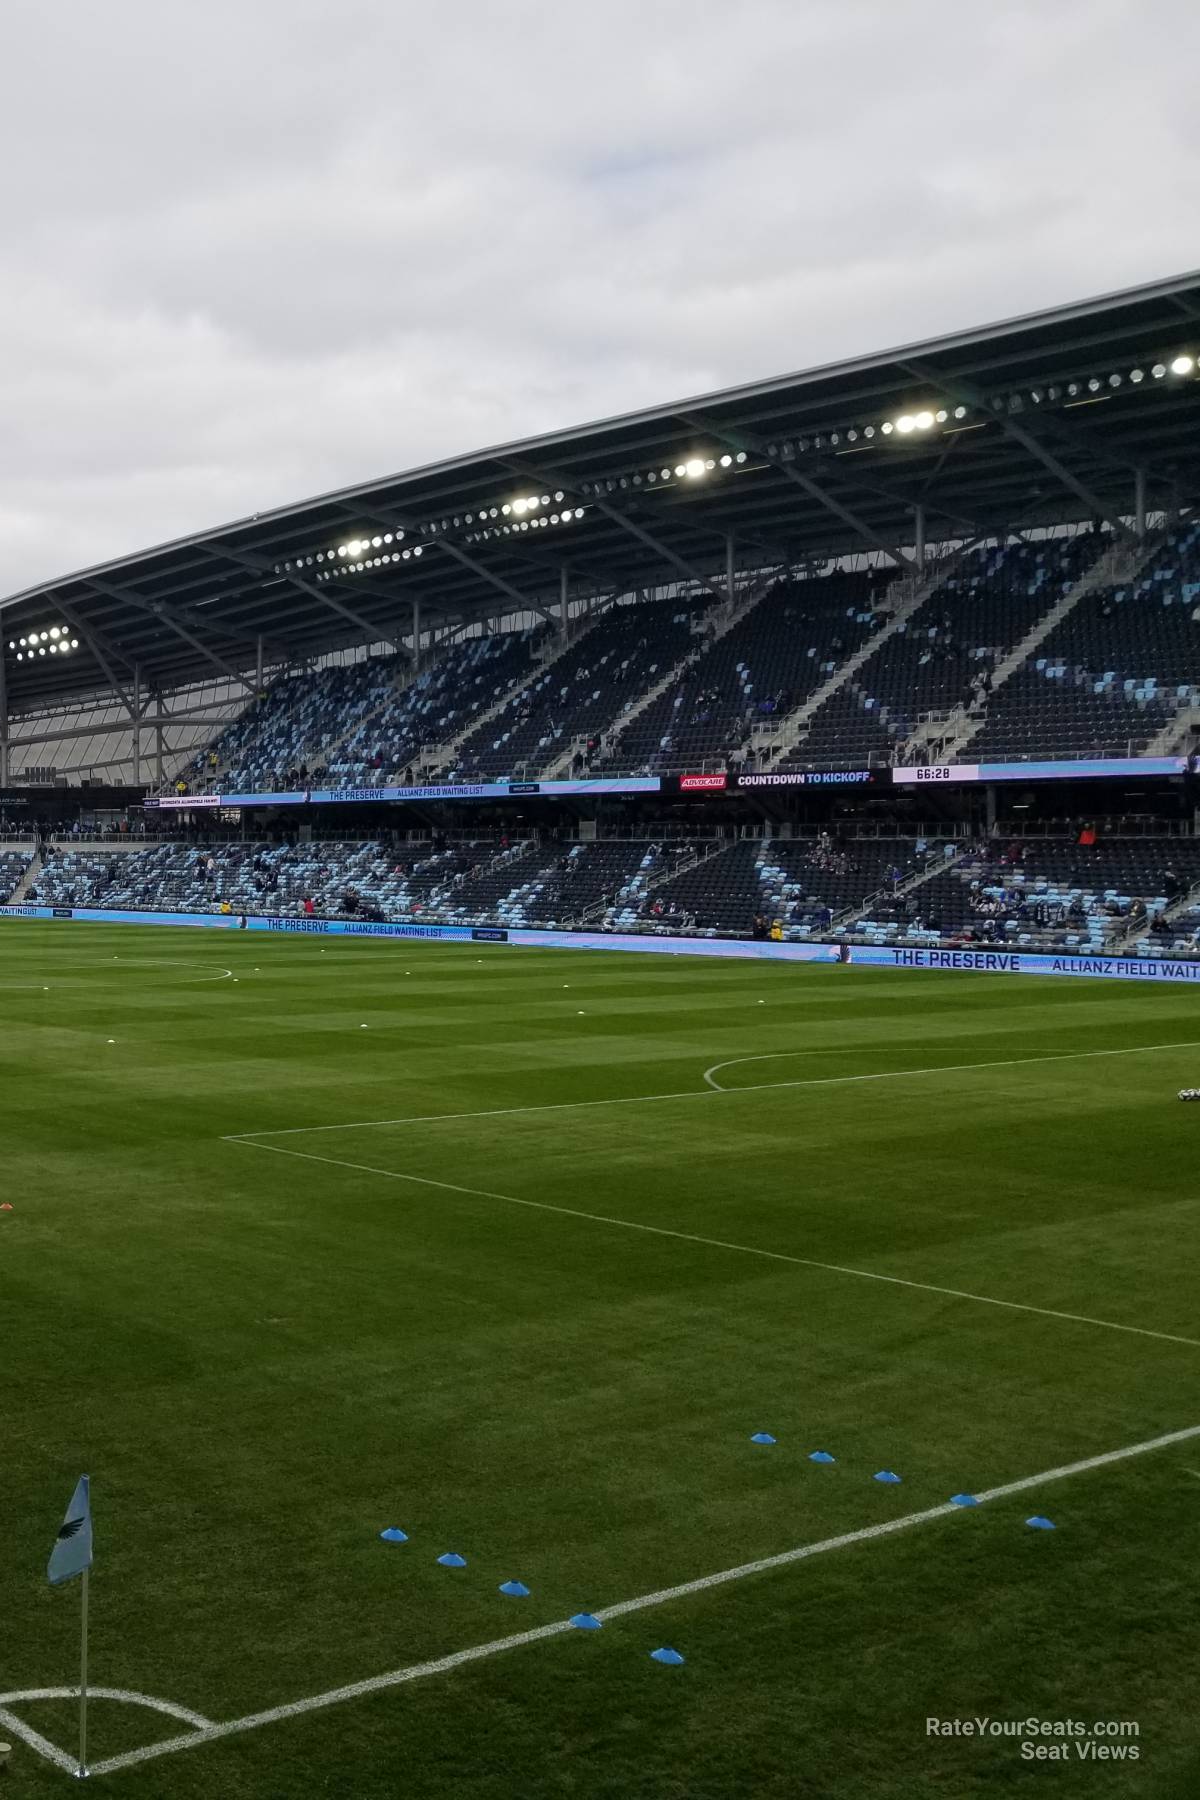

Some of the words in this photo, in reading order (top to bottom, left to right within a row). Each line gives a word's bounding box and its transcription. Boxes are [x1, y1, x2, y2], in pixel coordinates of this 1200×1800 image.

[738, 774, 805, 786] COUNTDOWN
[807, 773, 822, 784] TO
[916, 768, 950, 780] 66:28
[683, 777, 725, 787] ADVOCARE
[329, 791, 344, 801] THE
[345, 790, 385, 800] PRESERVE
[397, 788, 423, 797] ALLIANZ
[423, 788, 441, 796] FIELD
[441, 787, 468, 796] WAITING
[469, 786, 484, 795] LIST
[267, 919, 283, 930] THE
[285, 920, 329, 932] PRESERVE
[343, 924, 373, 934] ALLIANZ
[373, 925, 393, 935] FIELD
[393, 926, 425, 937] WAITING
[426, 928, 442, 938] LIST
[892, 949, 924, 966] THE
[929, 951, 1021, 971] PRESERVE
[1052, 959, 1112, 974] ALLIANZ
[1116, 962, 1157, 976] FIELD
